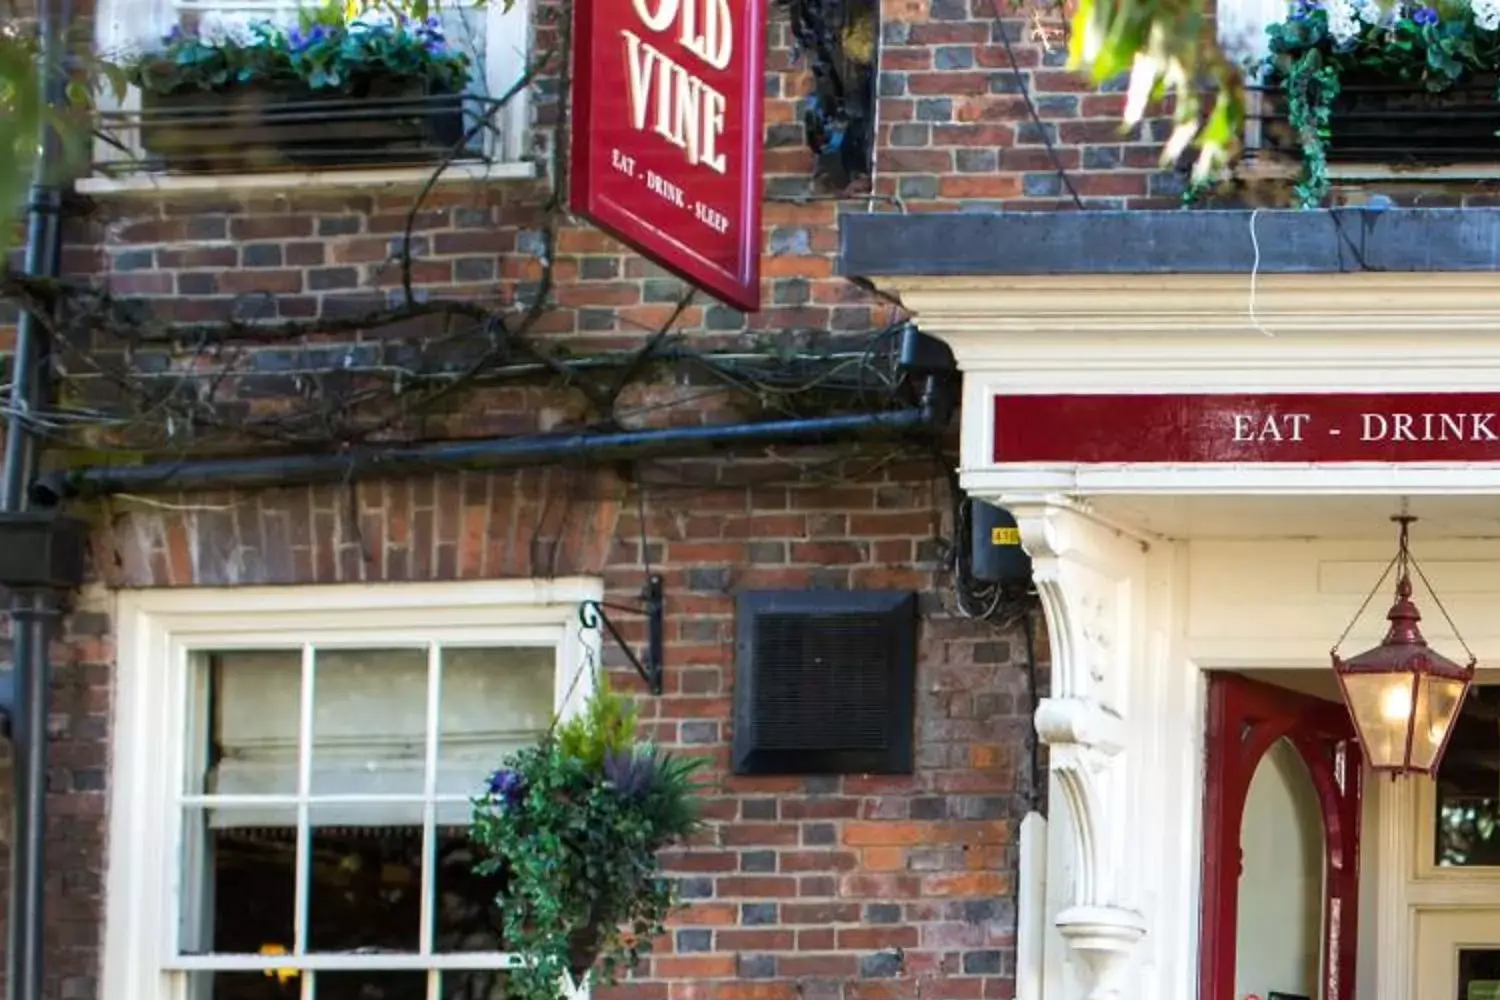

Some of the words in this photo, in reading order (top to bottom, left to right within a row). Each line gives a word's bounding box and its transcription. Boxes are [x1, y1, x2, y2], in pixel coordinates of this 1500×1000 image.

[620, 29, 727, 174] VINE
[612, 148, 636, 177] EAT
[647, 170, 685, 208] DRINK
[695, 201, 730, 234] SLEEP
[1232, 413, 1311, 442] EAT
[1360, 412, 1499, 442] DRINK
